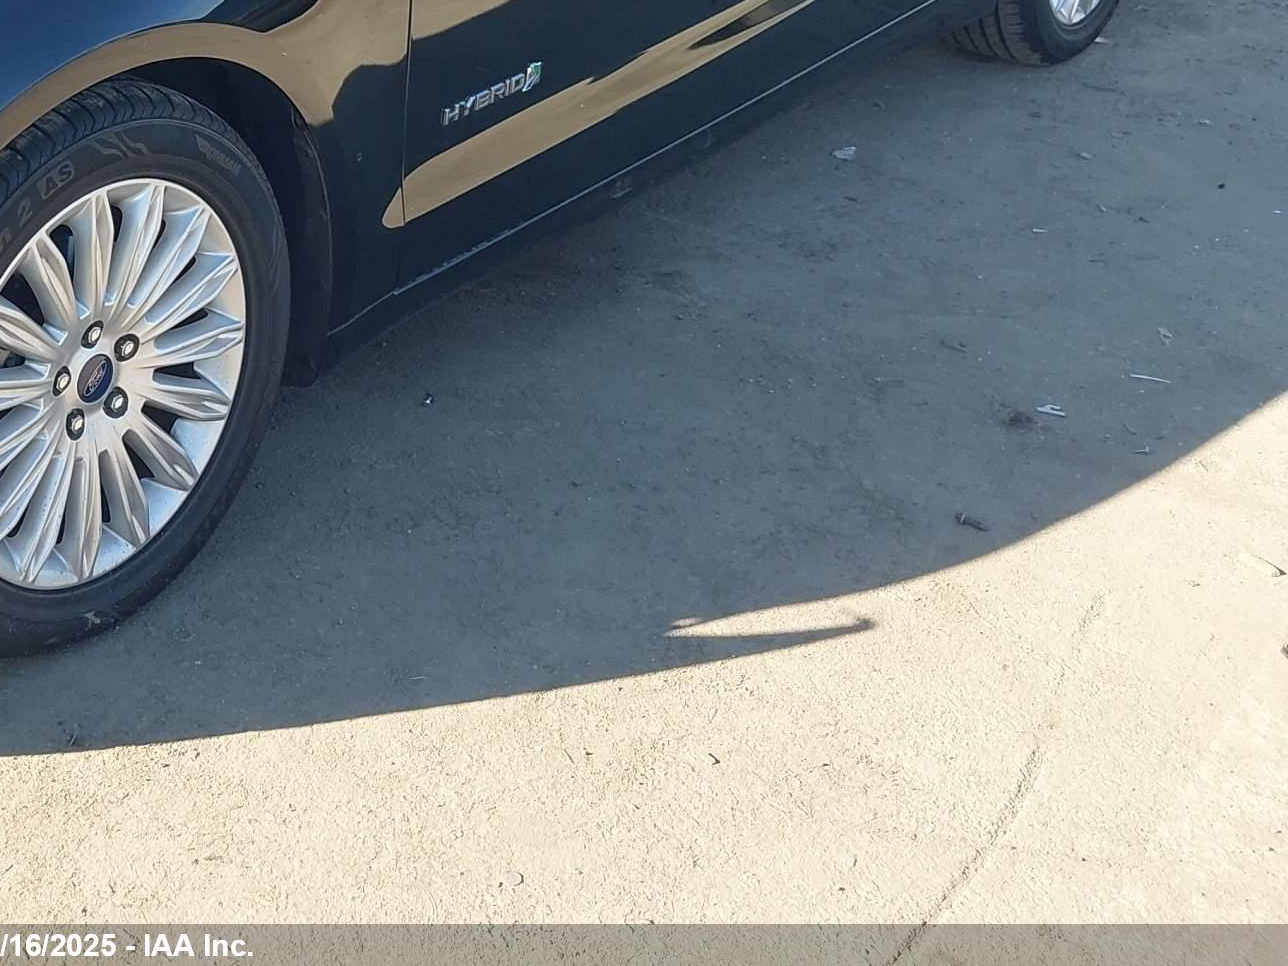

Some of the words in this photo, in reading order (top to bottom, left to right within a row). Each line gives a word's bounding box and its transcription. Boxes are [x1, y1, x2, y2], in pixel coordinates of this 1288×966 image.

[440, 72, 525, 126] HYBRID
[16, 197, 33, 227] 2
[40, 160, 75, 199] AS
